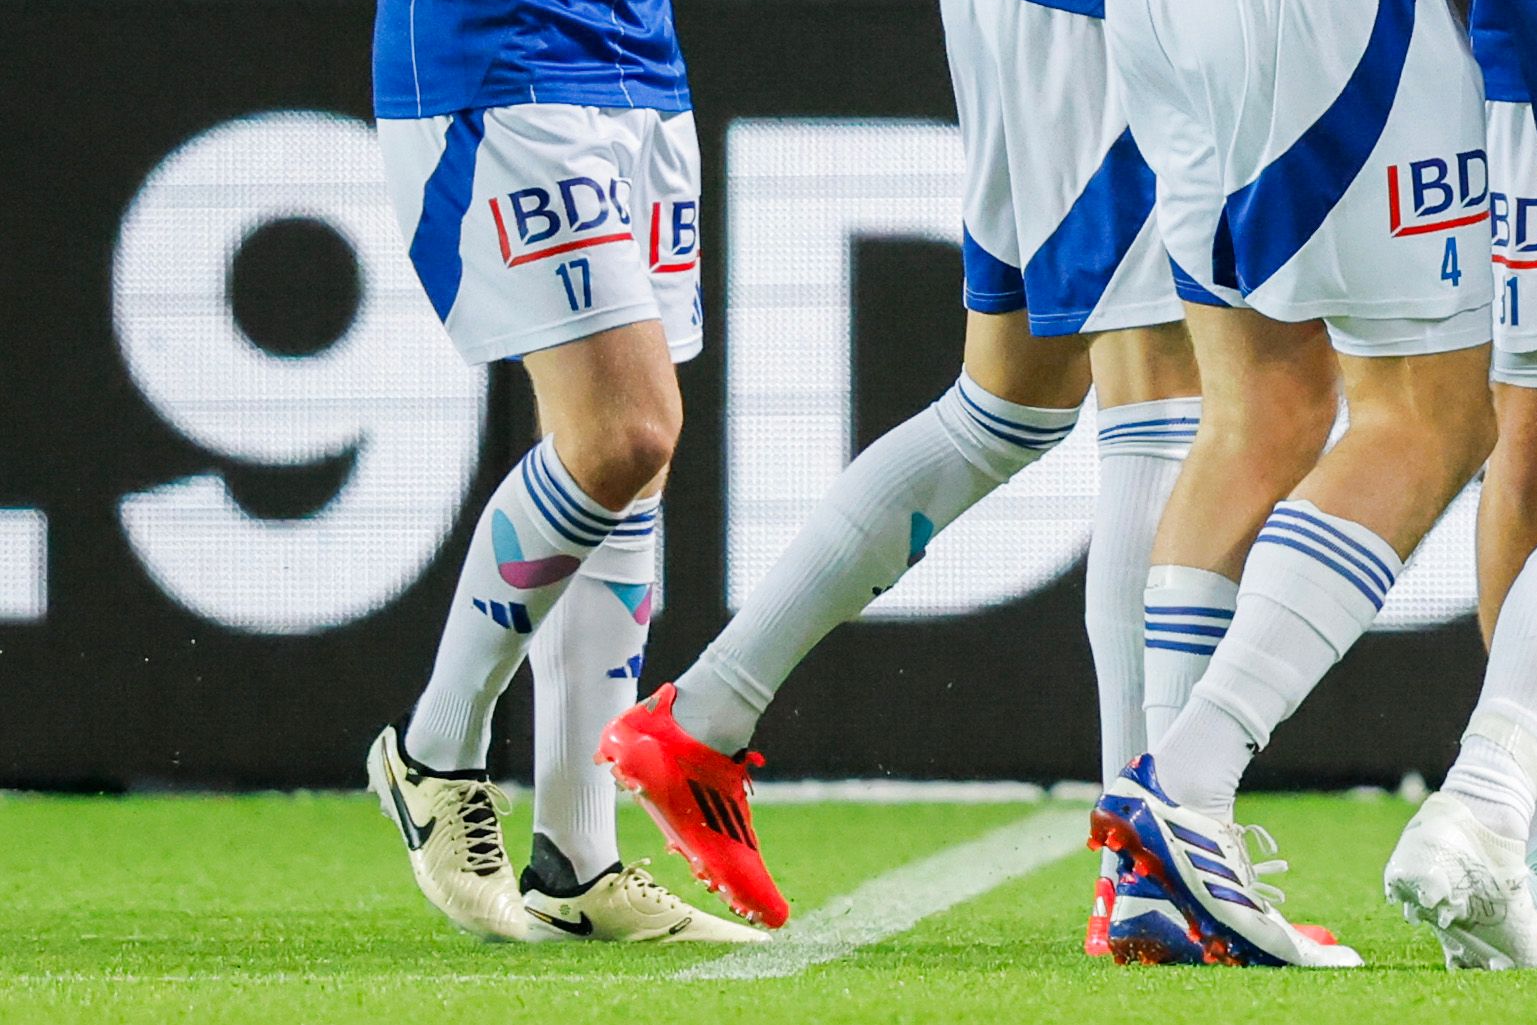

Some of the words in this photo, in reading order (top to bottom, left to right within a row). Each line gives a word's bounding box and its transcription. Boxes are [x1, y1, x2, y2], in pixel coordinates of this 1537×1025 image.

[1408, 148, 1490, 218] BD
[554, 256, 593, 312] 17
[1440, 236, 1462, 287] 4
